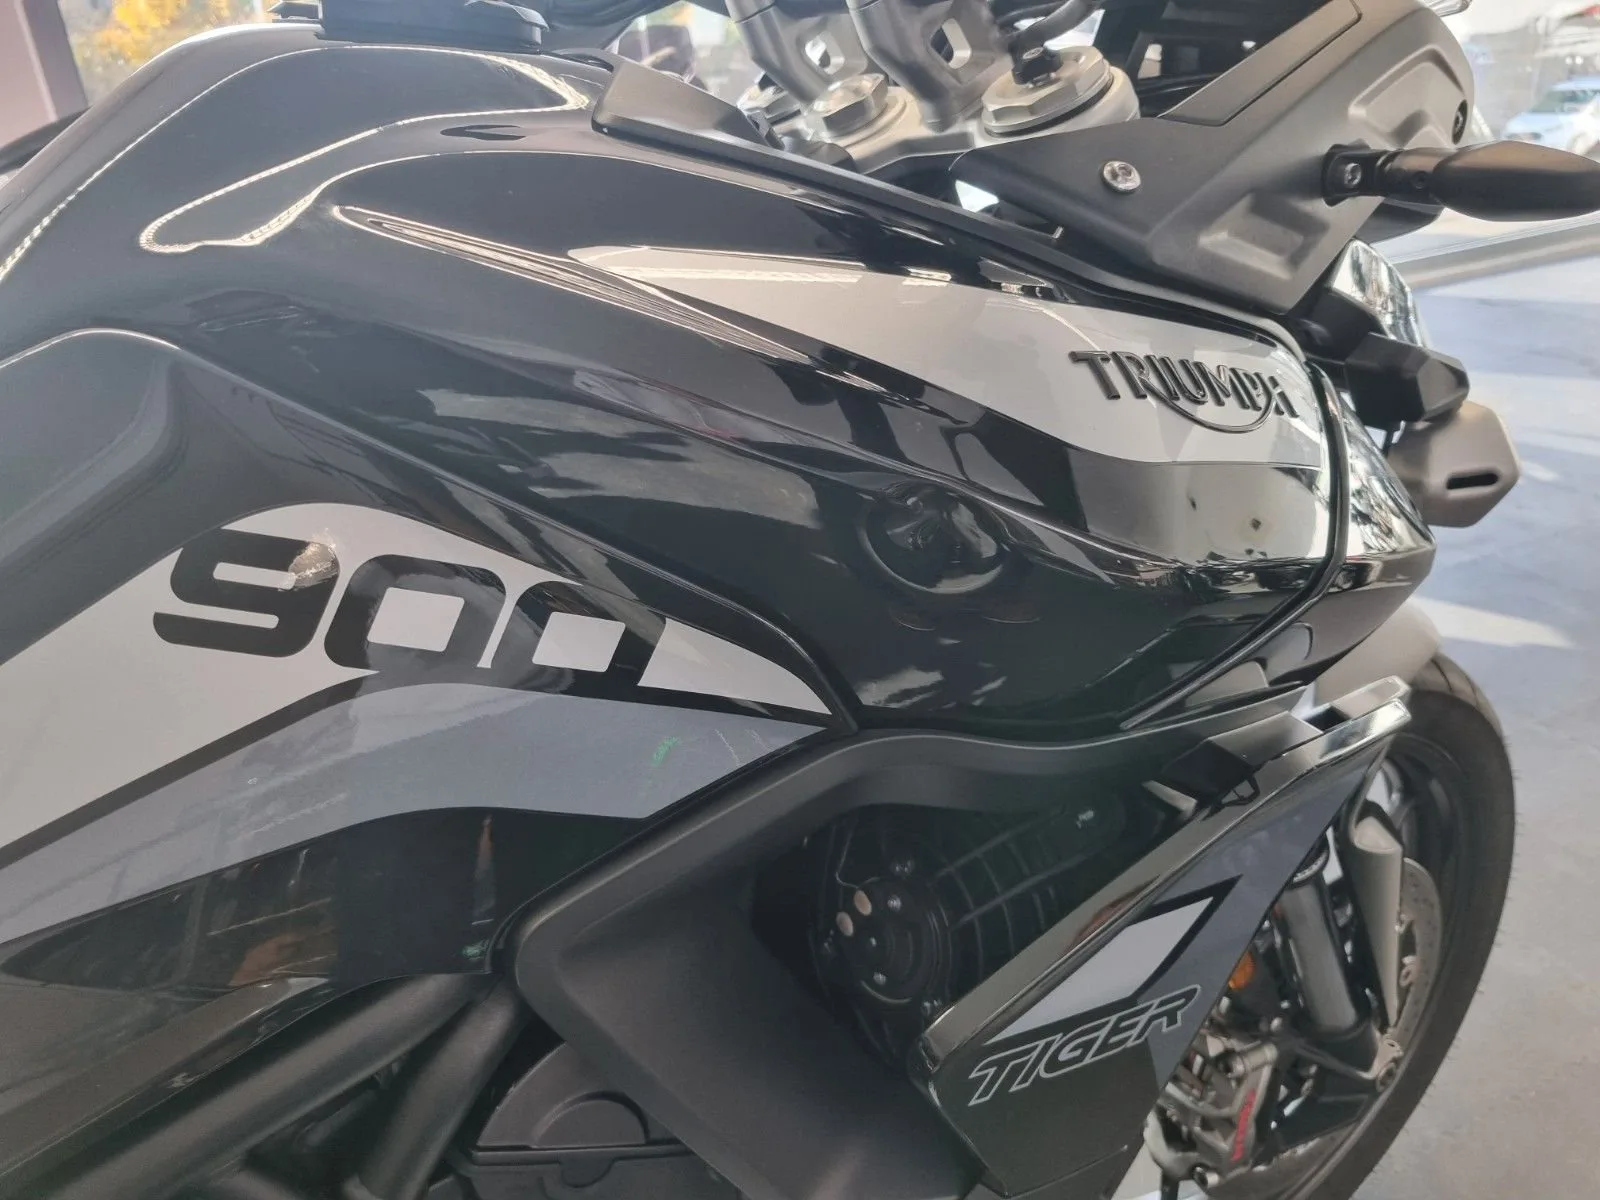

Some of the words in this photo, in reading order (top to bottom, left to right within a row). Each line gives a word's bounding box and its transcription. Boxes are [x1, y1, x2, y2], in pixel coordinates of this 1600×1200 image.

[1068, 350, 1299, 434] TRIUMPH
[153, 527, 666, 688] 900
[968, 984, 1201, 1107] TIGER
